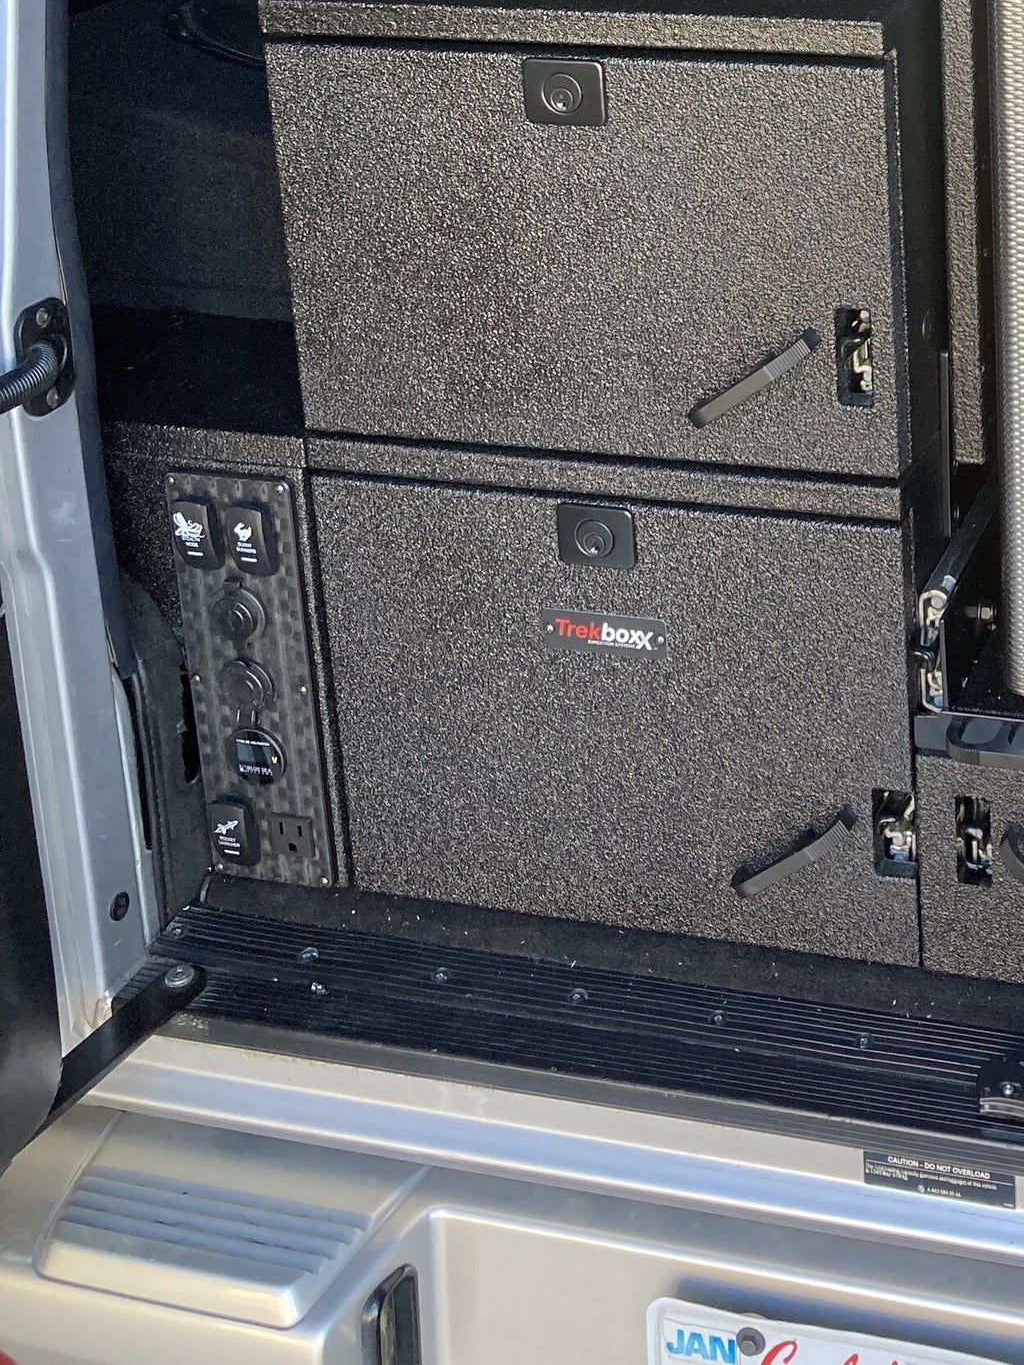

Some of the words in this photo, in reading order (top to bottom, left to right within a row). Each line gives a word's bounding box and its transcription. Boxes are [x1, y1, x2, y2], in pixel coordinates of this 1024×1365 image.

[555, 618, 654, 650] Trekboxx
[887, 1155, 919, 1168] CAUTION
[924, 1161, 935, 1172] DO
[936, 1163, 952, 1174] NOT
[952, 1166, 991, 1180] OVERLOAD
[666, 1329, 737, 1364] JAN
